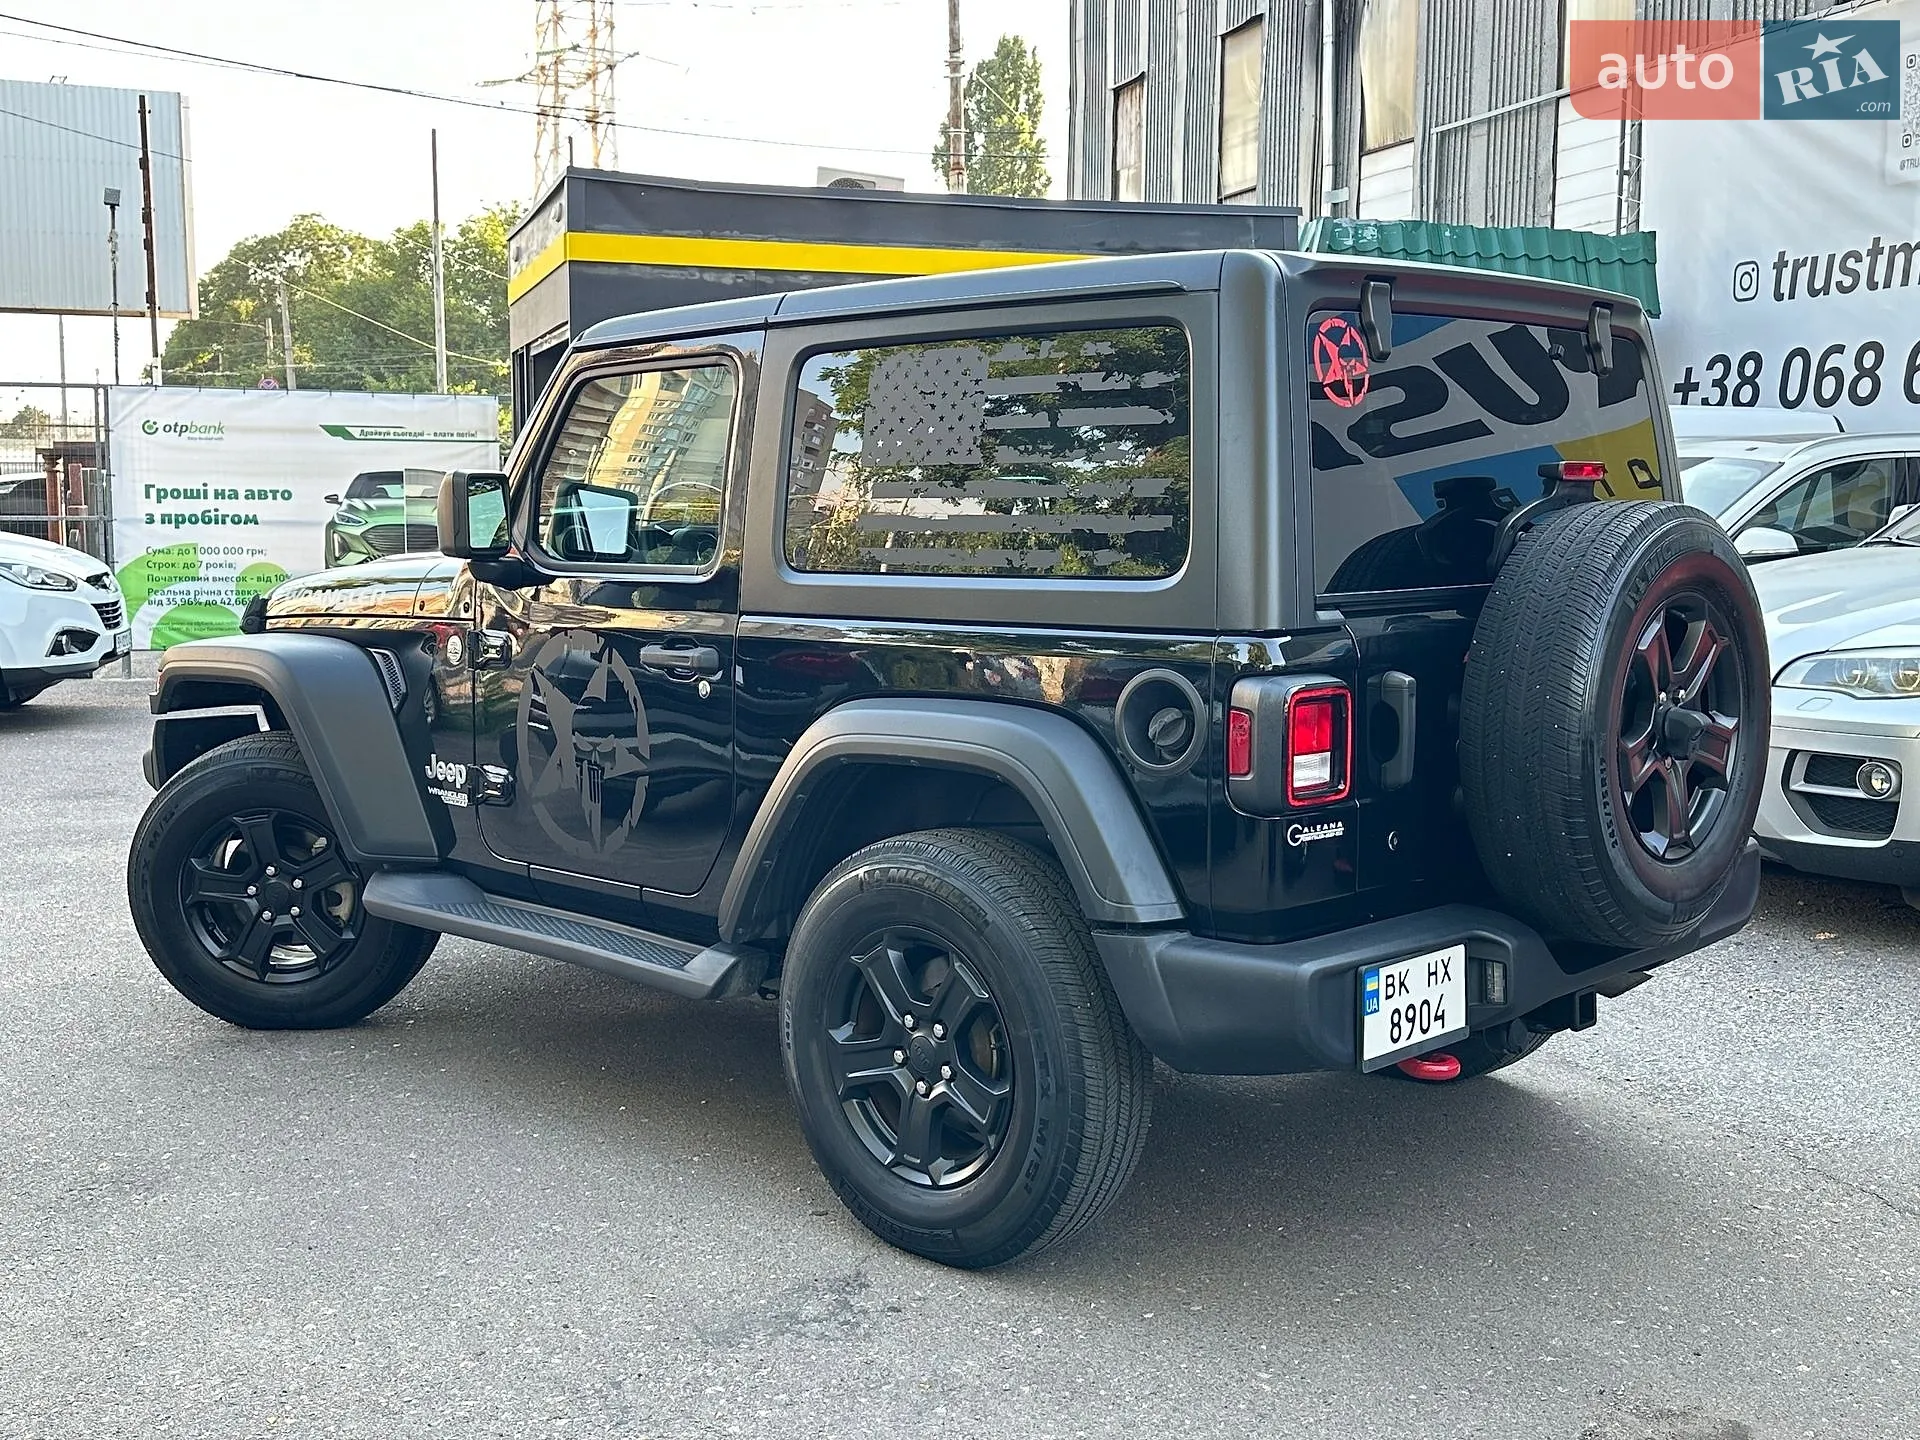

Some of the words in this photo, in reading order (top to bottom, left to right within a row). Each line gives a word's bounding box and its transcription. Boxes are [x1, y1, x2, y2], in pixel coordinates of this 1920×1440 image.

[1673, 350, 1764, 408] +38
[1778, 340, 1886, 410] 068
[163, 420, 225, 437] otpbank
[144, 482, 209, 504] Гроші
[213, 488, 240, 501] на
[244, 488, 293, 501] авто
[144, 512, 156, 526] з
[160, 507, 260, 529] пробігом
[145, 546, 175, 558] Сума:
[177, 547, 191, 556] до
[193, 546, 198, 556] 1
[199, 546, 220, 556] 000
[222, 546, 244, 556] 000
[145, 560, 181, 571] Строк:
[182, 561, 197, 571] до
[198, 560, 204, 569] 7
[205, 560, 238, 572] років;
[146, 573, 210, 584] Початковий
[211, 574, 248, 584] внесок
[256, 573, 273, 584] від
[147, 587, 191, 597] Реальна
[193, 587, 222, 600] річна
[147, 597, 164, 607] від
[166, 597, 202, 608] 35,96%
[204, 598, 219, 608] до
[424, 753, 467, 790] Jeep
[1287, 821, 1344, 847] GALEANA
[1366, 997, 1379, 1013] UA
[1389, 992, 1446, 1044] 8904
